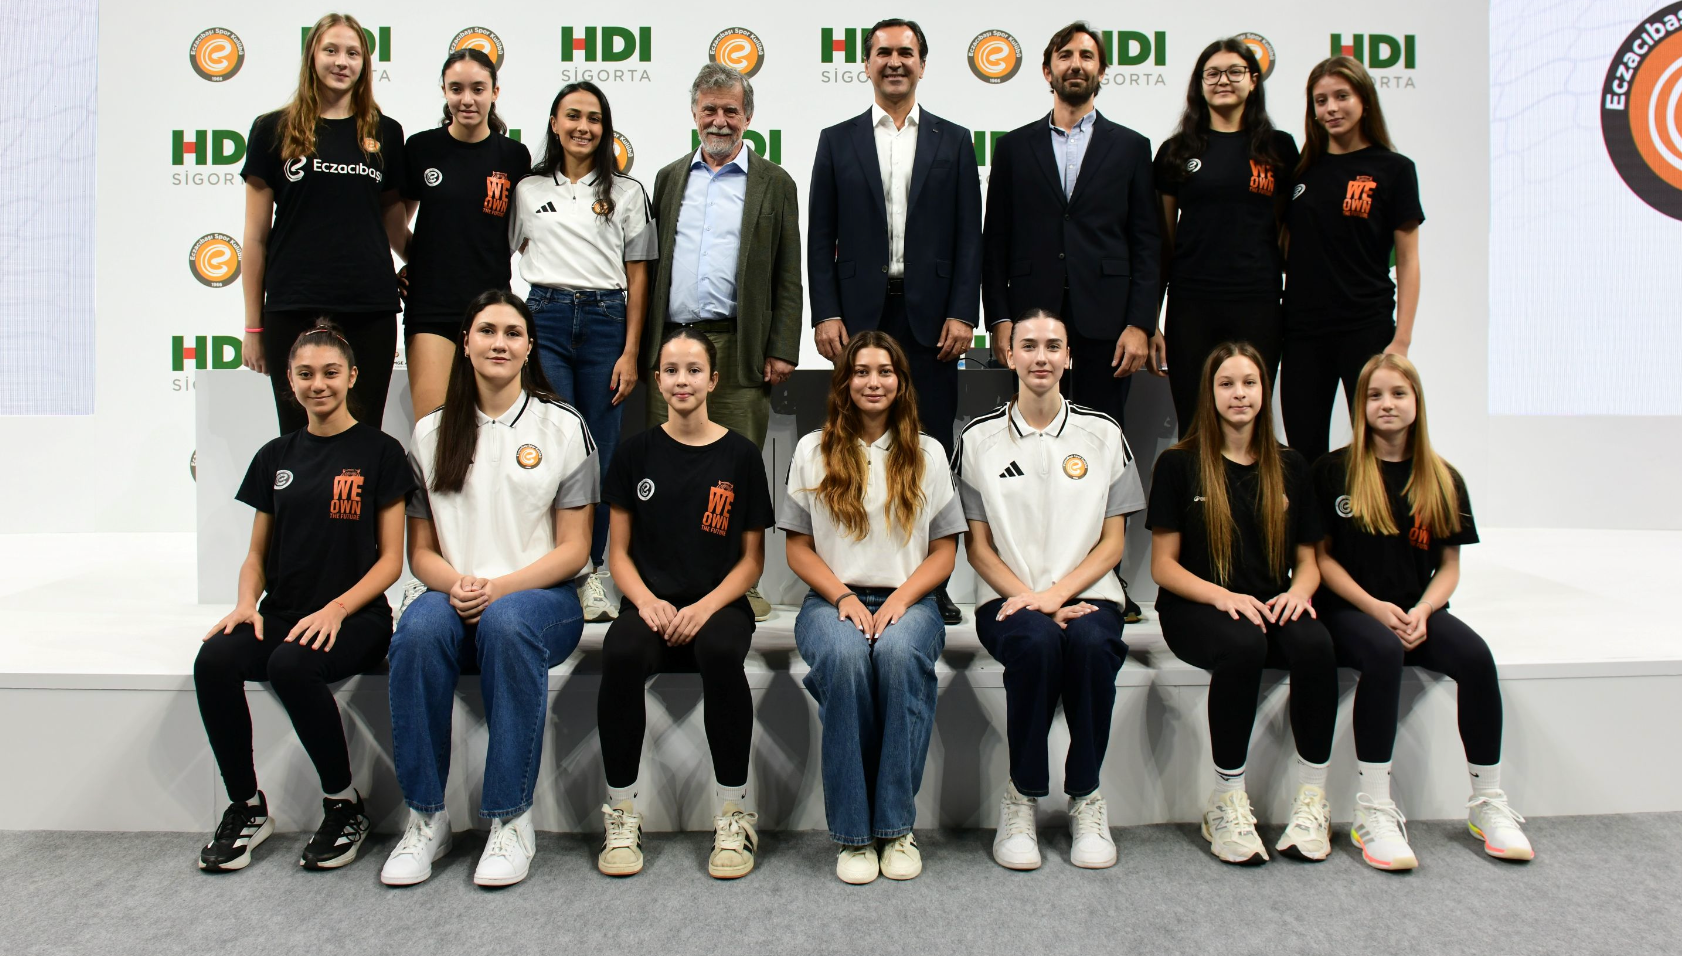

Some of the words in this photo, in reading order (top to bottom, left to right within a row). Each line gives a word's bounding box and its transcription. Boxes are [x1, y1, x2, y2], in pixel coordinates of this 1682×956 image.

[215, 28, 231, 37] Spor
[474, 27, 490, 35] Spor
[734, 28, 750, 36] Spor
[993, 30, 1008, 38] Spor
[561, 26, 651, 62] HDI
[1330, 33, 1416, 69] HDI
[1605, 9, 1682, 110] Eczacıba
[561, 66, 651, 82] SİGORTA
[821, 68, 869, 83] SİGO
[1100, 73, 1166, 86] GORTA
[172, 129, 247, 165] HD
[172, 170, 245, 186] SİGOR
[1250, 176, 1274, 192] OWN
[486, 176, 511, 201] WE
[1346, 180, 1377, 202] WE
[484, 197, 509, 213] OWN
[1343, 199, 1372, 214] OWN
[214, 233, 230, 241] Spor
[172, 336, 243, 371] HD
[333, 475, 365, 501] WE
[330, 499, 362, 514] OWN
[708, 486, 735, 518] WE
[702, 511, 729, 531] OWN
